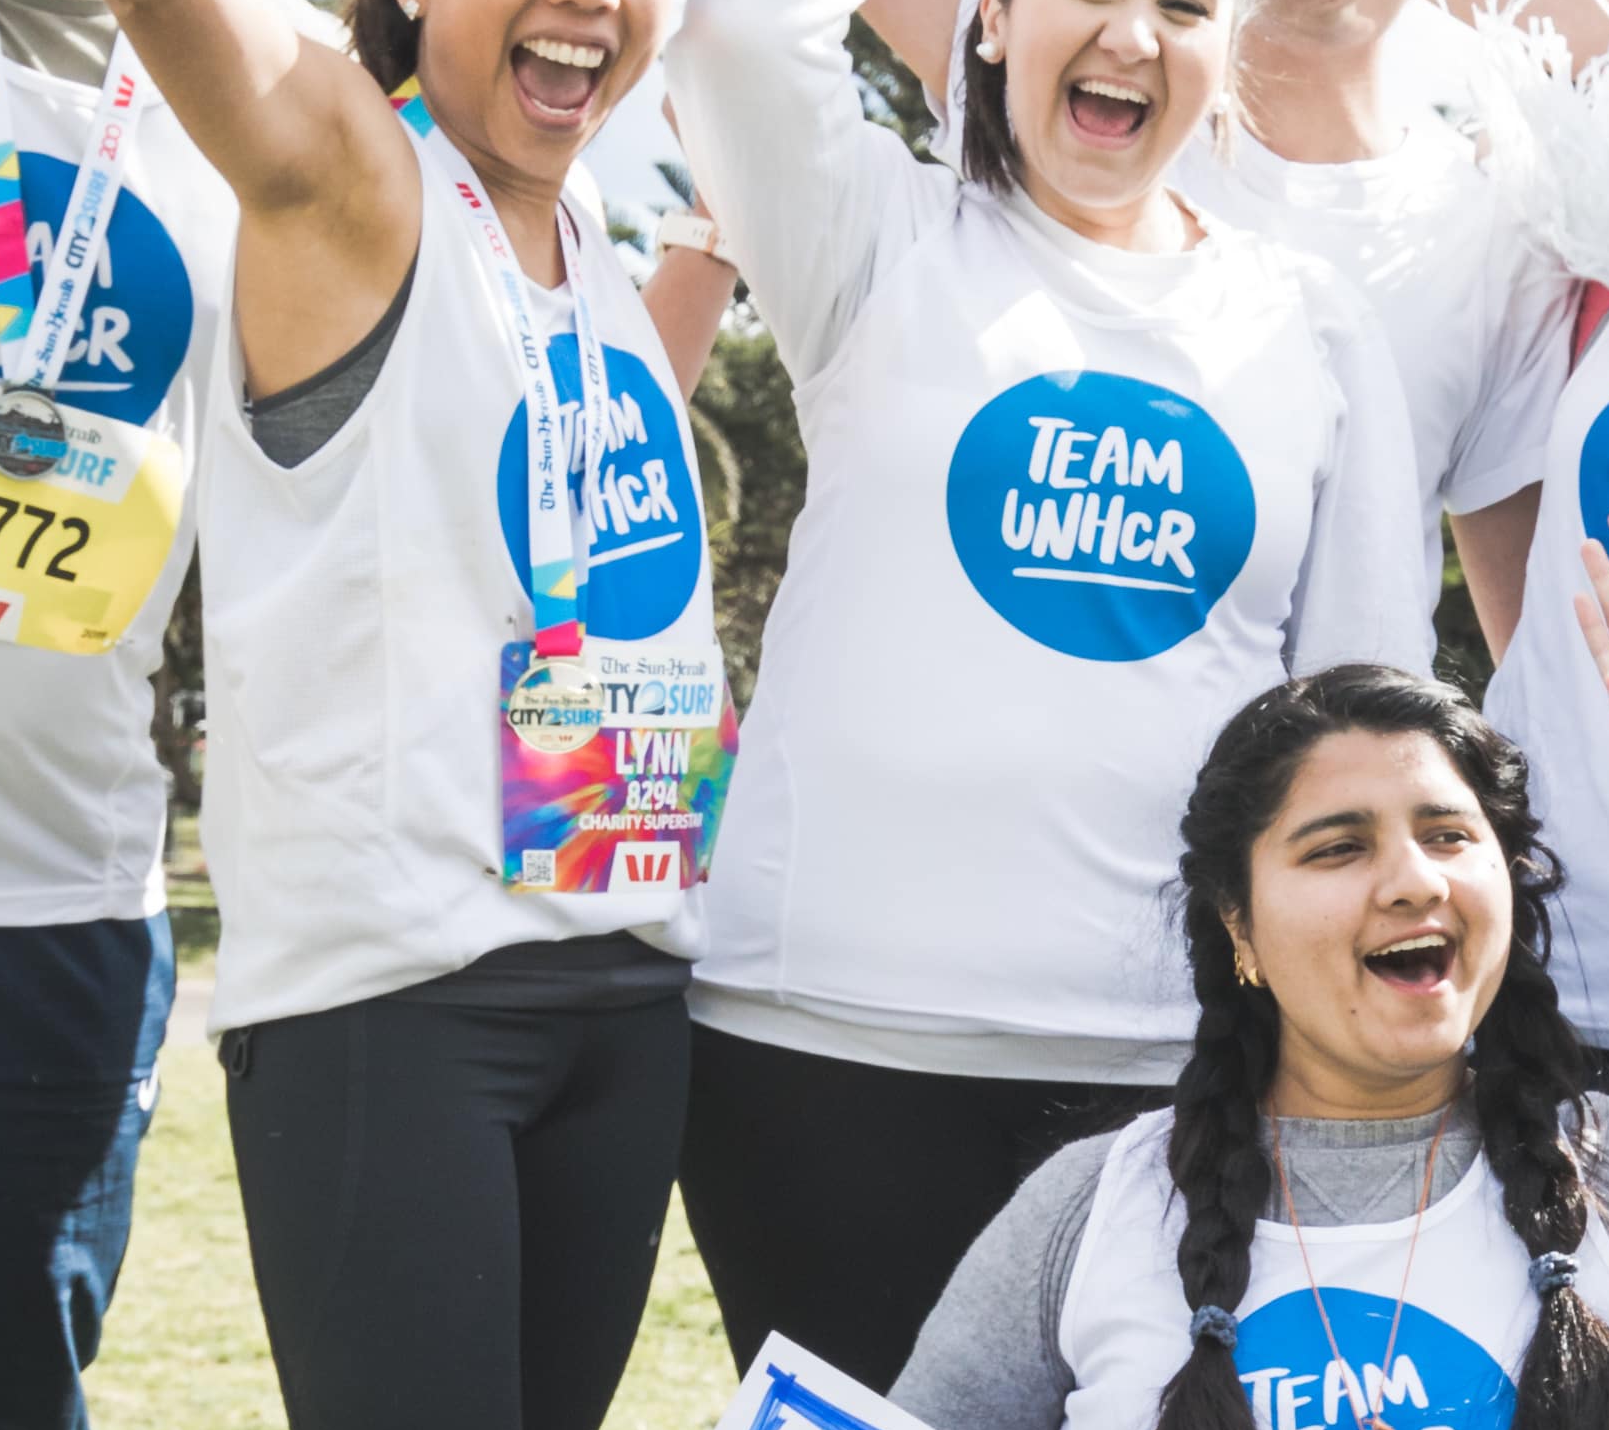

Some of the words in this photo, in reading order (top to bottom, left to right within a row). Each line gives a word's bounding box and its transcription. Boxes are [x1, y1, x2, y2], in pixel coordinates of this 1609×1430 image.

[1028, 416, 1184, 494] TEAM
[1001, 488, 1196, 578] UNHCR
[600, 656, 632, 674] The
[509, 707, 603, 726] CITY2SURF
[615, 730, 691, 775] LYNN
[625, 780, 679, 811] 8294
[578, 813, 643, 831] CHARITY
